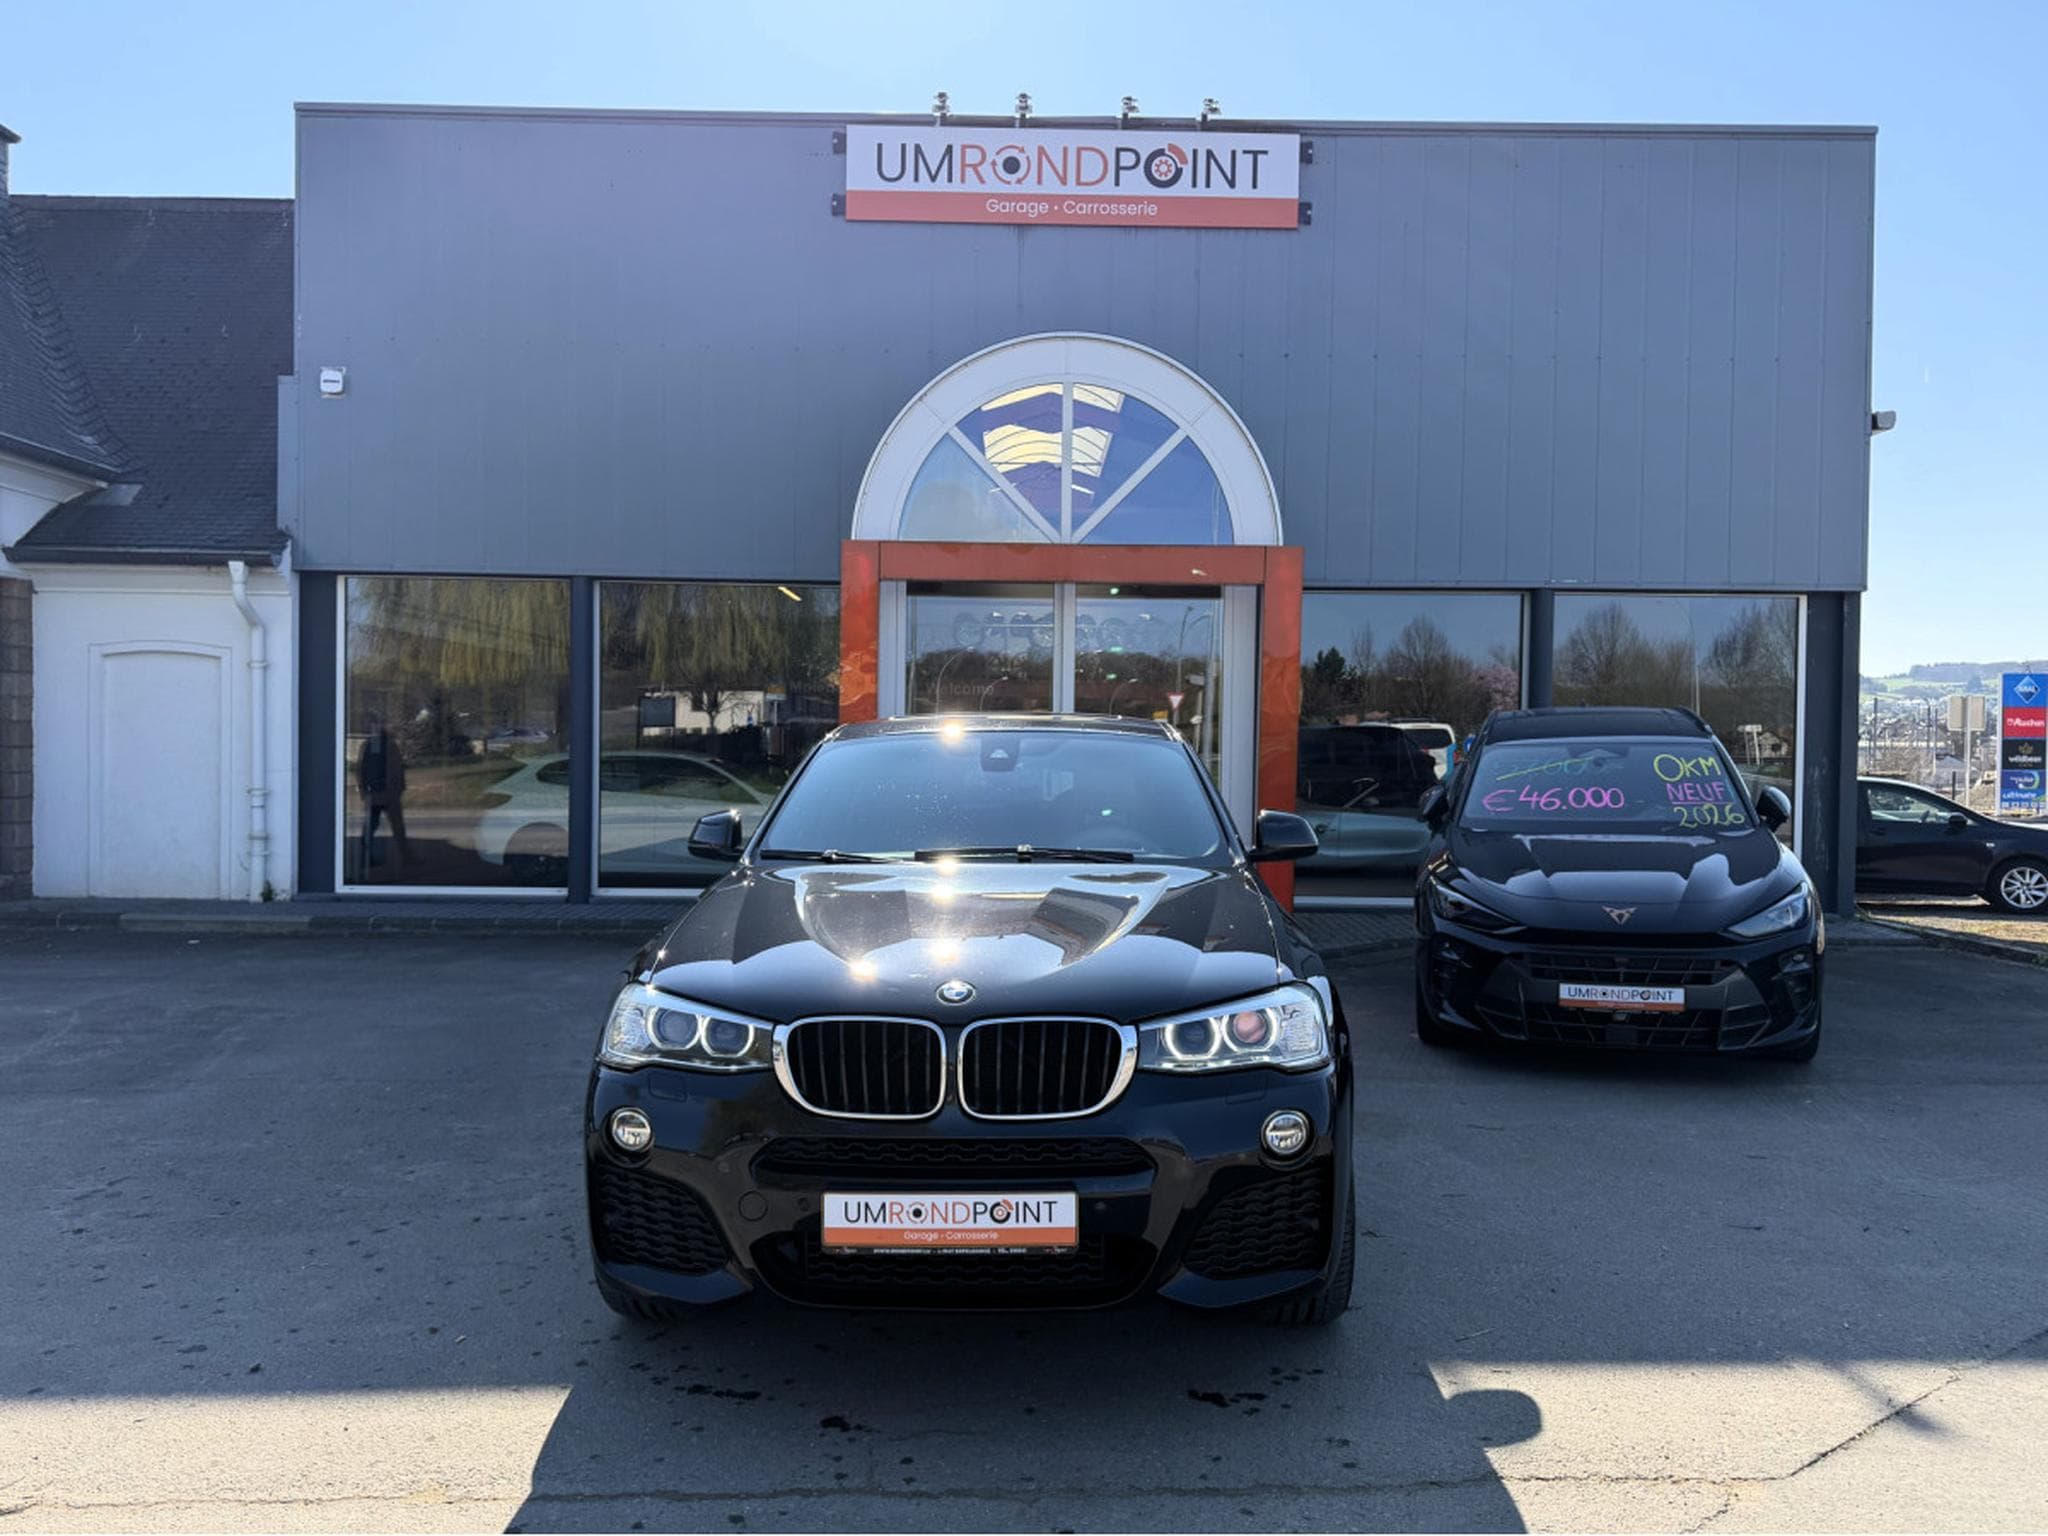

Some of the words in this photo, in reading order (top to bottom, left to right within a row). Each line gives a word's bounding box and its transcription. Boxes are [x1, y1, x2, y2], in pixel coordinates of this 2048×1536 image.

[986, 199, 1049, 217] Garage
[1063, 201, 1158, 215] Carrosserie
[1666, 782, 1726, 802] NEUF
[1674, 804, 1745, 828] 2026
[904, 1231, 939, 1241] Garage
[945, 1231, 999, 1240] Carrosserie
